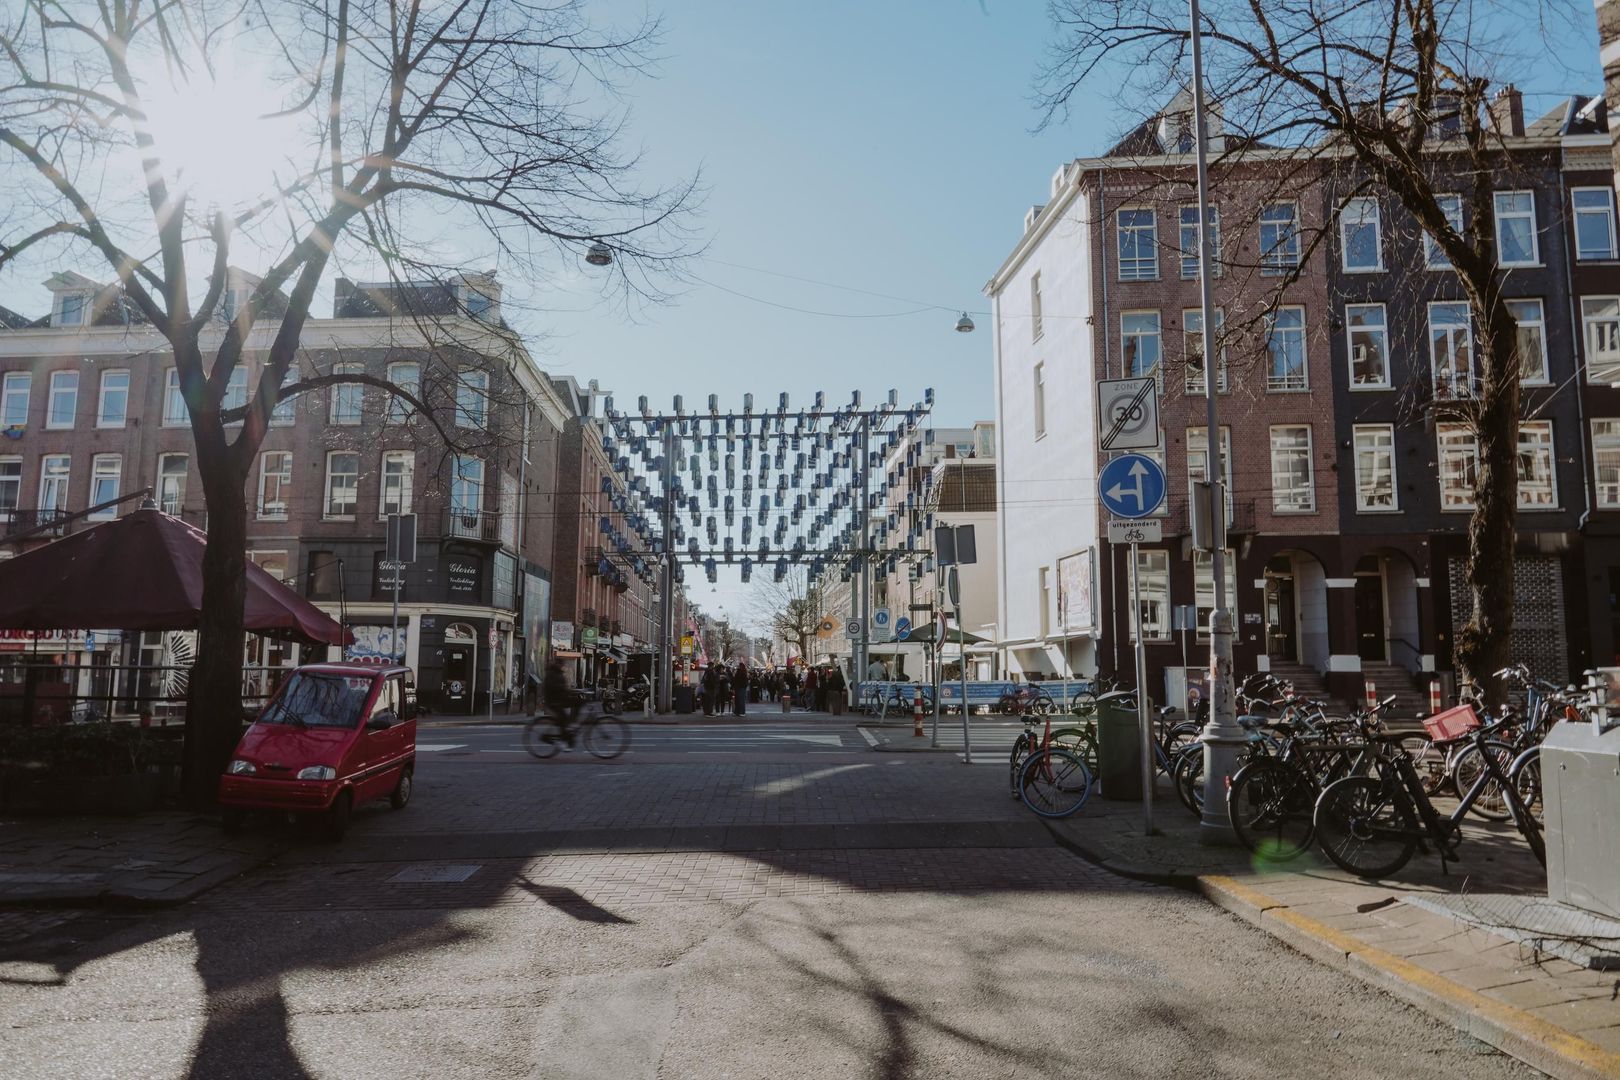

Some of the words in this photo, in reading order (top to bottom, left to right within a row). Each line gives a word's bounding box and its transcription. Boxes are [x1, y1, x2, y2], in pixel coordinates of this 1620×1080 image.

[1114, 382, 1138, 391] ZONE
[1115, 406, 1143, 422] 30
[1112, 521, 1157, 529] uitgezonderd
[449, 563, 477, 574] Gloria
